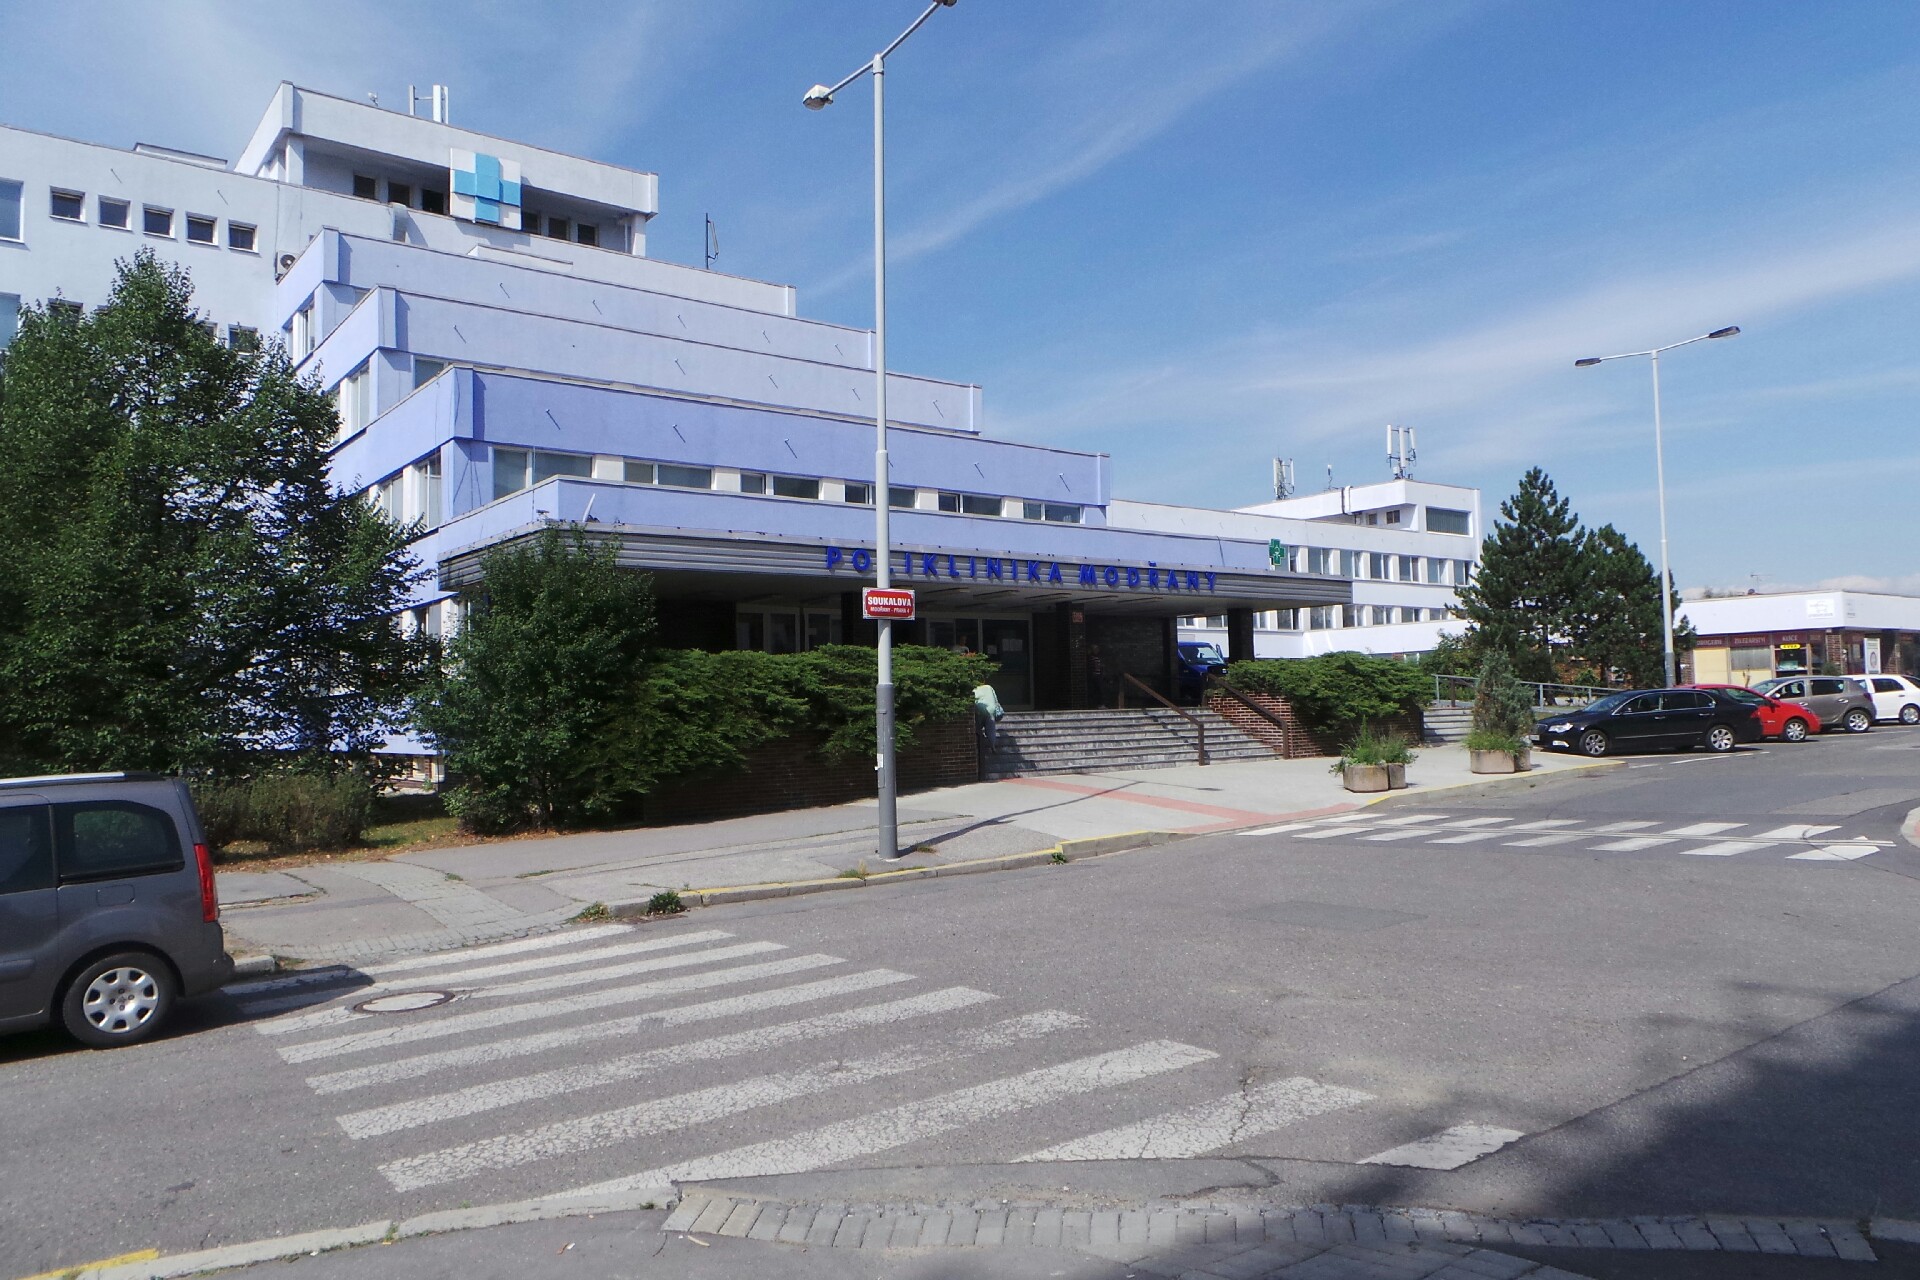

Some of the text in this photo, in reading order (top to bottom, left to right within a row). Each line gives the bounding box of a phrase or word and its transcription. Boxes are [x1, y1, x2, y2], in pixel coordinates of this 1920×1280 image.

[825, 545, 1217, 592] POIKLINIKA MODŘANY
[867, 596, 912, 606] SOUKALOVA
